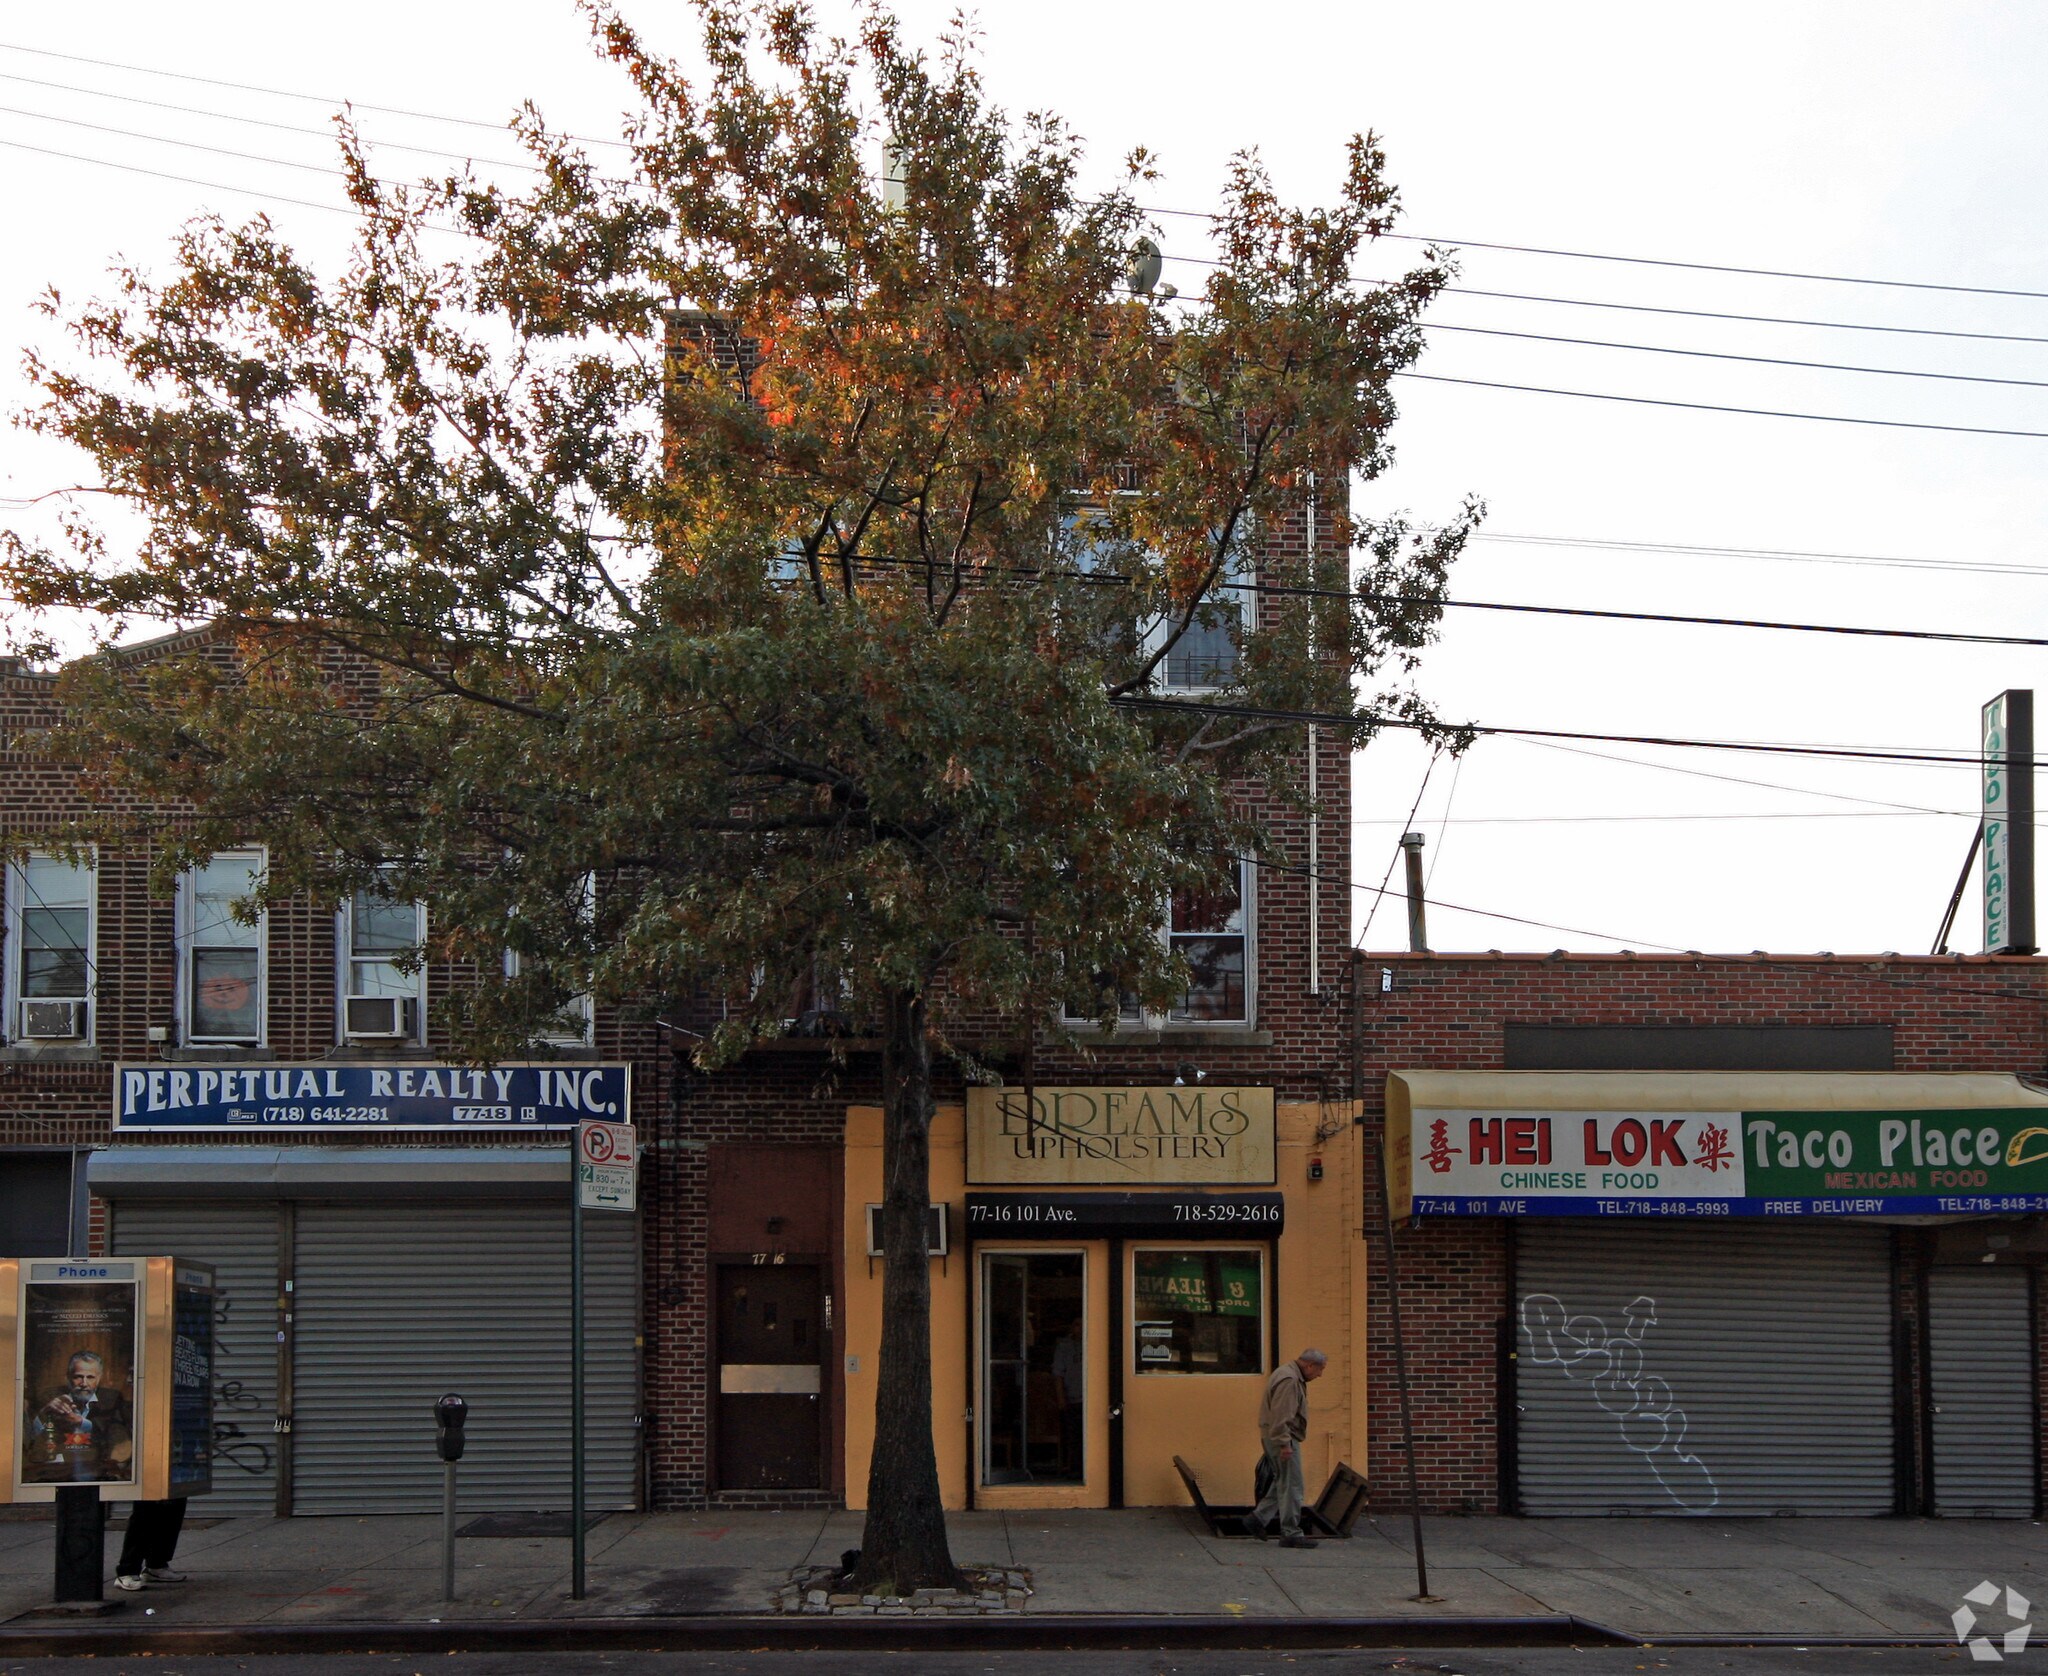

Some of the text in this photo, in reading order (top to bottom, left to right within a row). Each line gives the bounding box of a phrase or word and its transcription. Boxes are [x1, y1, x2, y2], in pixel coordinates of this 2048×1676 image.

[1985, 703, 2000, 804] TACO
[1986, 822, 2001, 946] PLACE
[124, 1070, 617, 1116] PERPETUAL REALTY INC.
[263, 1107, 389, 1122] (718) 641-2281
[459, 1108, 507, 1119] 77-18
[998, 1090, 1249, 1136] DREAMS
[1013, 1136, 1231, 1159] UPHOLSTERY
[1420, 1118, 1462, 1173] 喜
[1469, 1118, 1552, 1165] HEI
[1583, 1118, 1688, 1166] LOK
[1693, 1122, 1735, 1173] 樂
[1747, 1119, 2000, 1168] Taco Place
[583, 1166, 591, 1181] 2
[1500, 1172, 1659, 1189] CHINESE FOOD
[1825, 1170, 1988, 1189] MEXICAN FOOD
[970, 1205, 1077, 1221] 77-16 101 Ave.
[1174, 1204, 1280, 1221] 718-529-2616
[1419, 1201, 1526, 1214] 77-14 101 AVE
[1597, 1201, 1729, 1215] TEL:718-848-5993
[1765, 1200, 1884, 1214] FREE DELIVERY
[752, 1253, 785, 1265] 77 16
[58, 1267, 107, 1277] Phone
